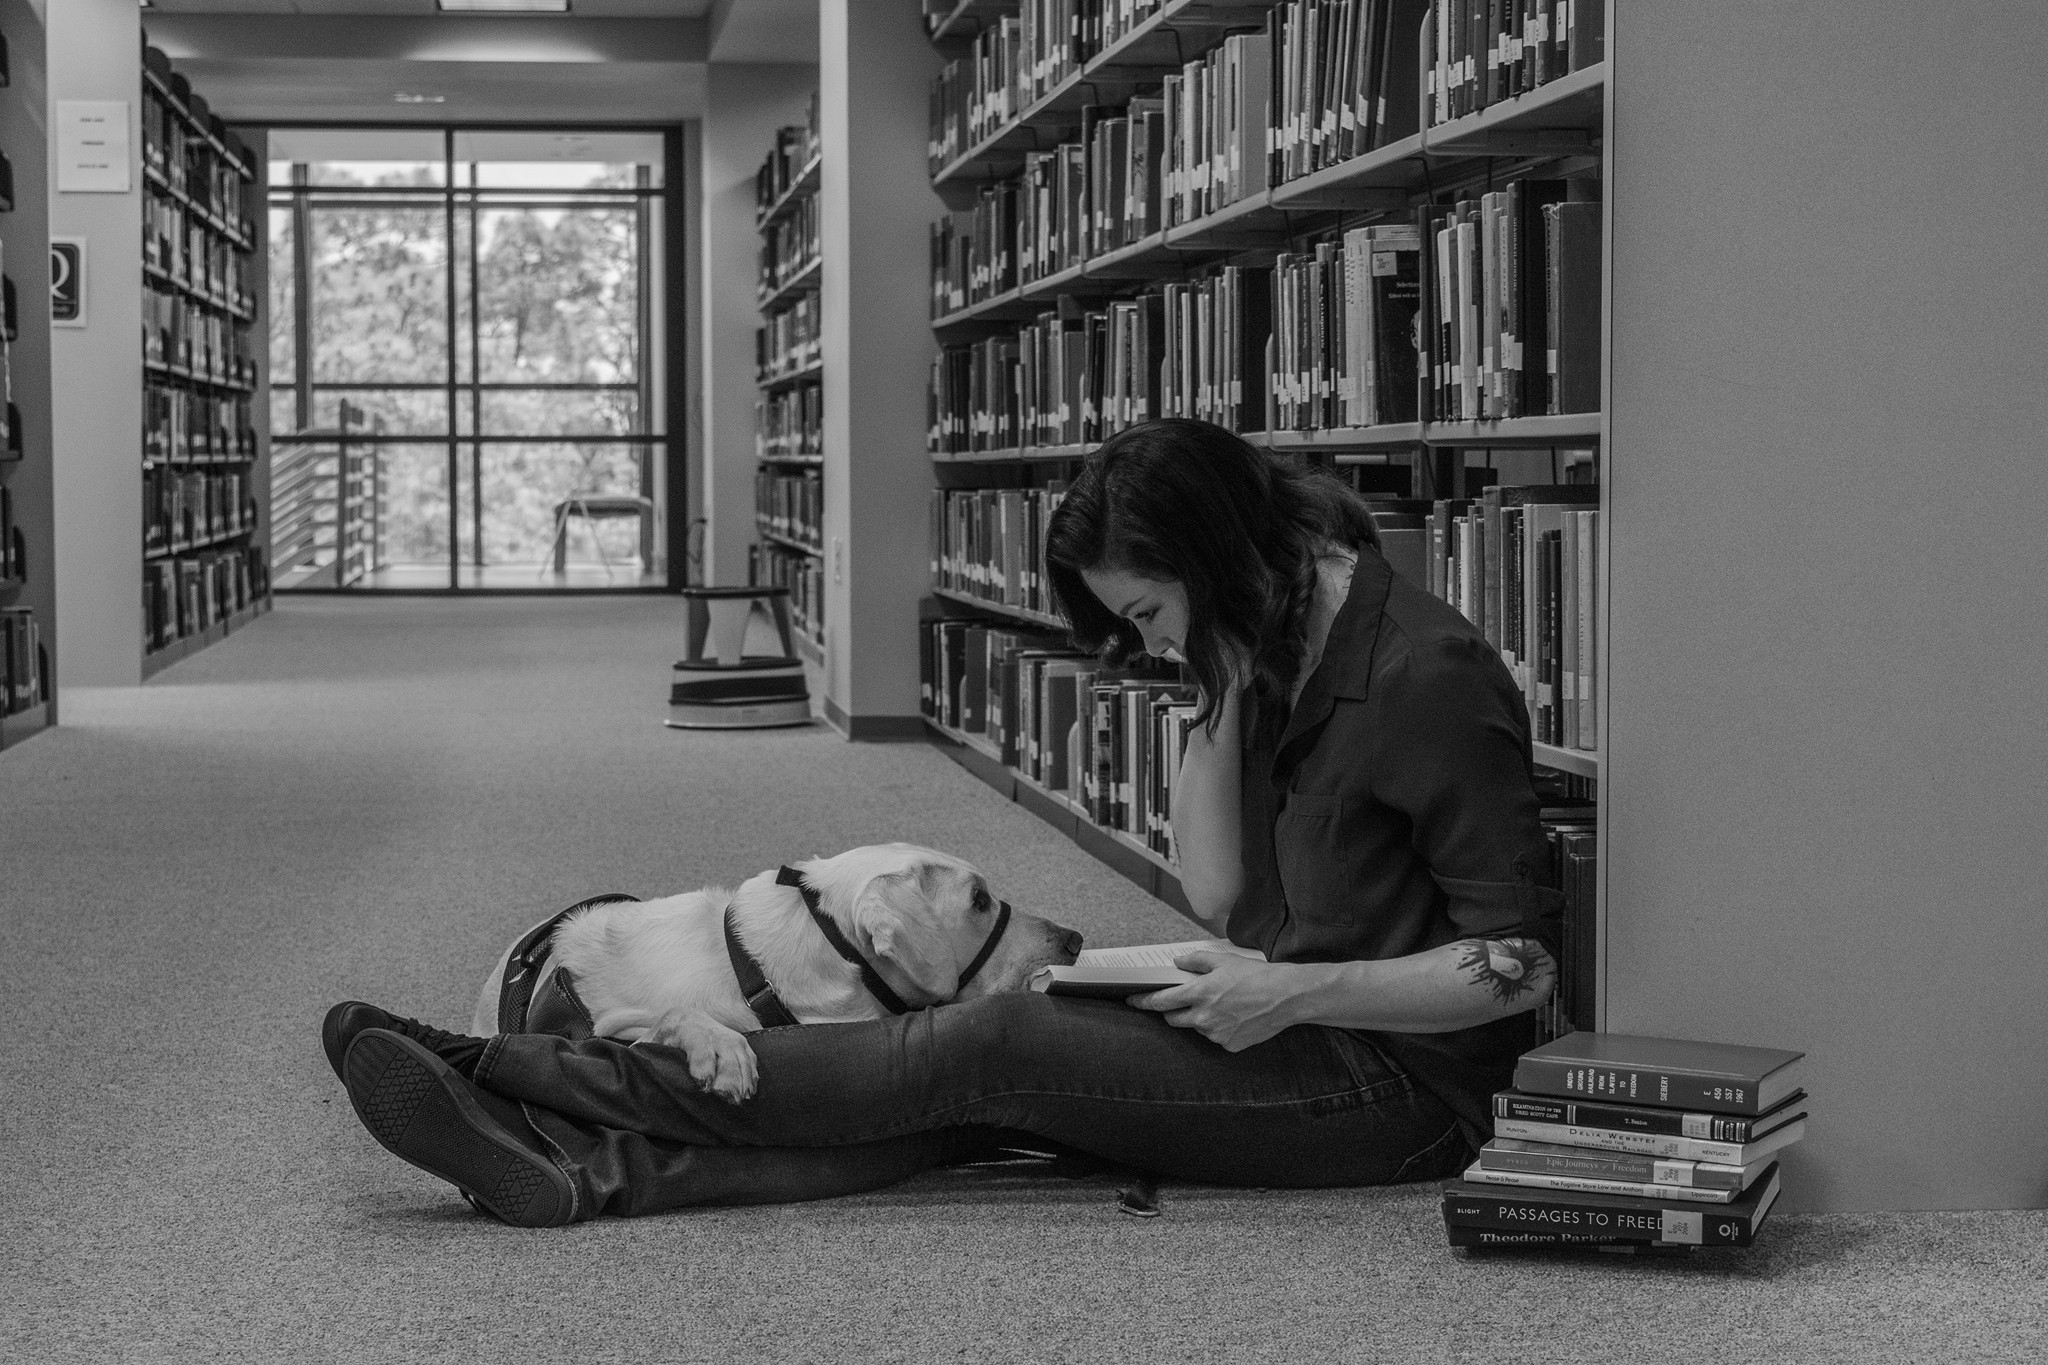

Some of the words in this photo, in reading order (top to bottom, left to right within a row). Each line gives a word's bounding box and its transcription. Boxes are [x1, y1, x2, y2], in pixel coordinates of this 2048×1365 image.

[1620, 1080, 1626, 1088] TO
[1660, 1076, 1668, 1101] SIEBERT
[1714, 1087, 1722, 1100] 450
[1512, 1103, 1546, 1112] EXAMINATION
[1570, 1128, 1601, 1138] DELIA
[1574, 1140, 1620, 1150] UNDERGROUND
[1623, 1146, 1652, 1154] RAILROAD
[1546, 1157, 1565, 1167] Epic
[1565, 1159, 1598, 1171] Journeys
[1613, 1163, 1647, 1173] Freedom
[1499, 1206, 1580, 1224] PASSAGES
[1585, 1212, 1608, 1225] TO
[1480, 1233, 1556, 1242] Theodore
